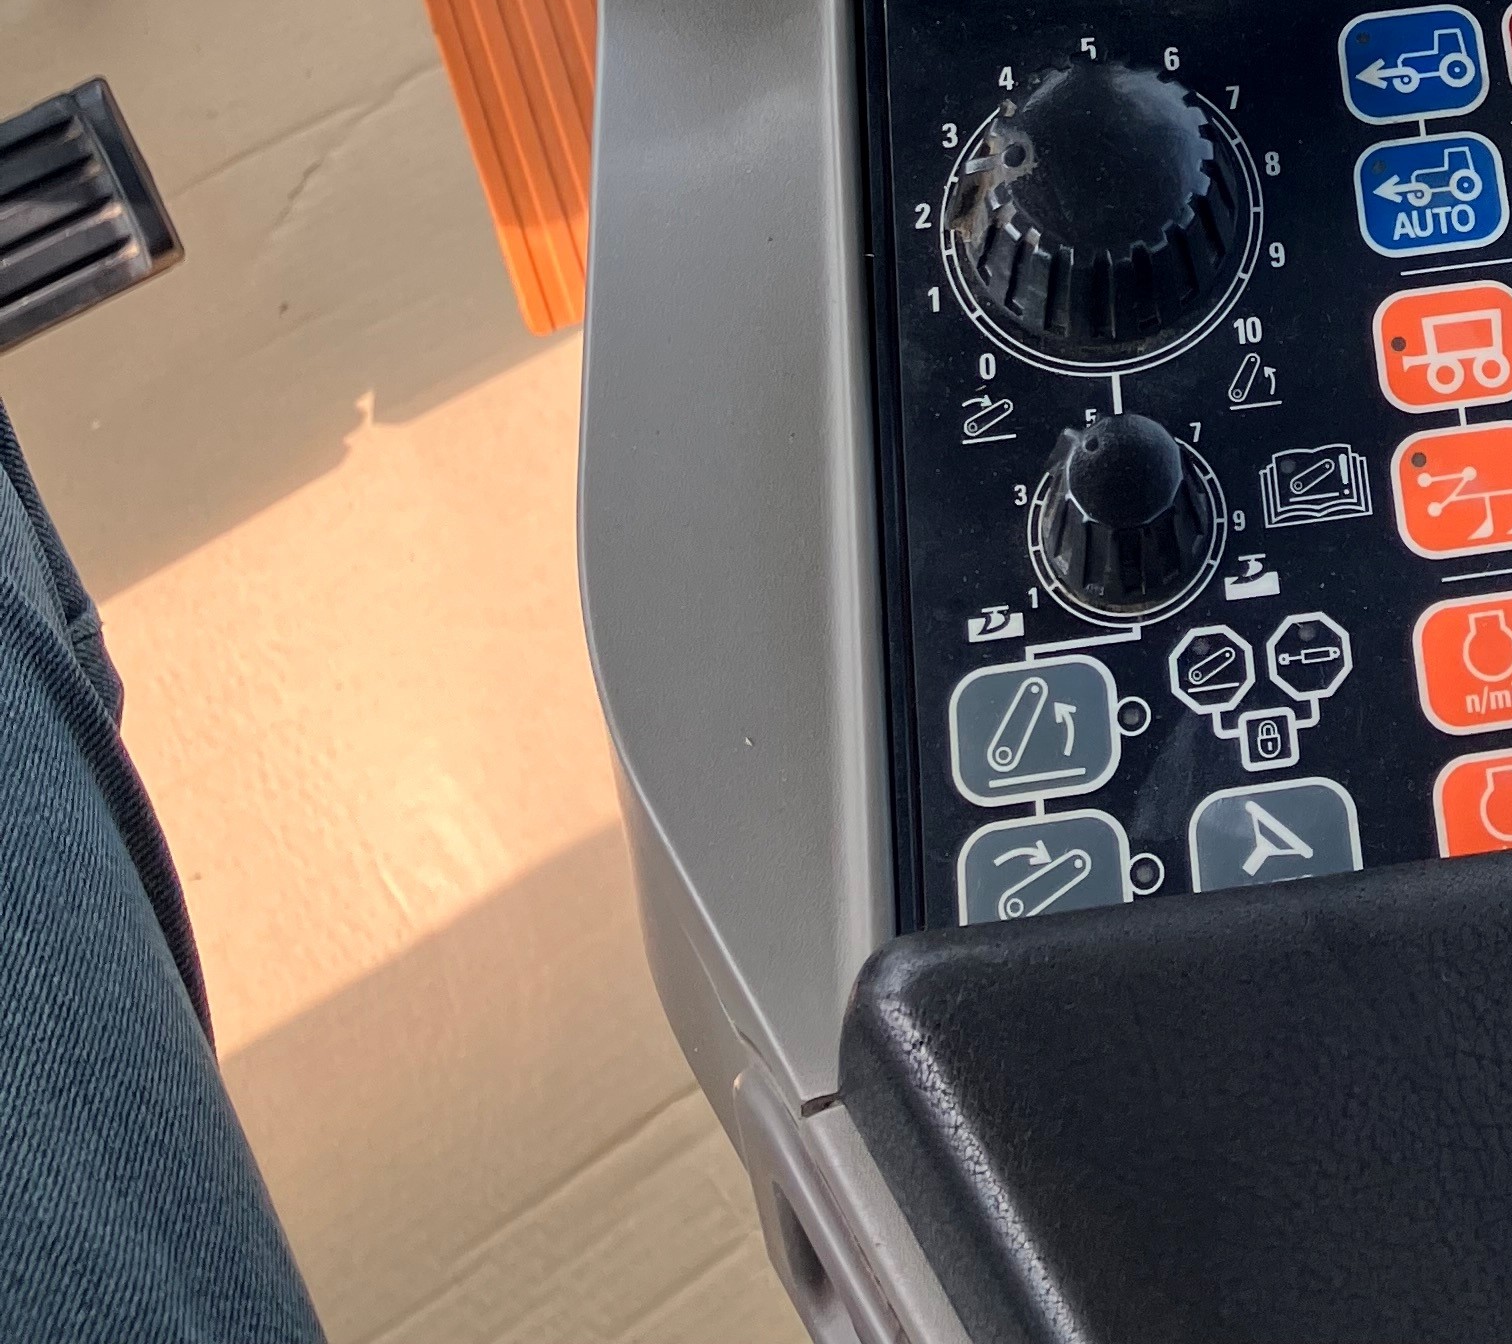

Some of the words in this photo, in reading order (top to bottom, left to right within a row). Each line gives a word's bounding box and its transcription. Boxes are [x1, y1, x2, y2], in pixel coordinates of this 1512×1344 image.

[1080, 37, 1097, 60] 5
[1163, 46, 1180, 71] 6
[998, 66, 1015, 91] 4
[1225, 85, 1240, 110] 7
[941, 122, 959, 149] 3
[1264, 151, 1281, 177] 8
[914, 202, 932, 230] 2
[1392, 203, 1476, 241] AUTO
[1268, 241, 1286, 268] 9
[927, 286, 940, 313] 1
[1233, 316, 1263, 345] 10
[979, 352, 996, 380] 0
[1189, 421, 1202, 443] 7
[1013, 484, 1028, 506] 3
[1232, 509, 1246, 532] 9
[1027, 586, 1039, 609] 1
